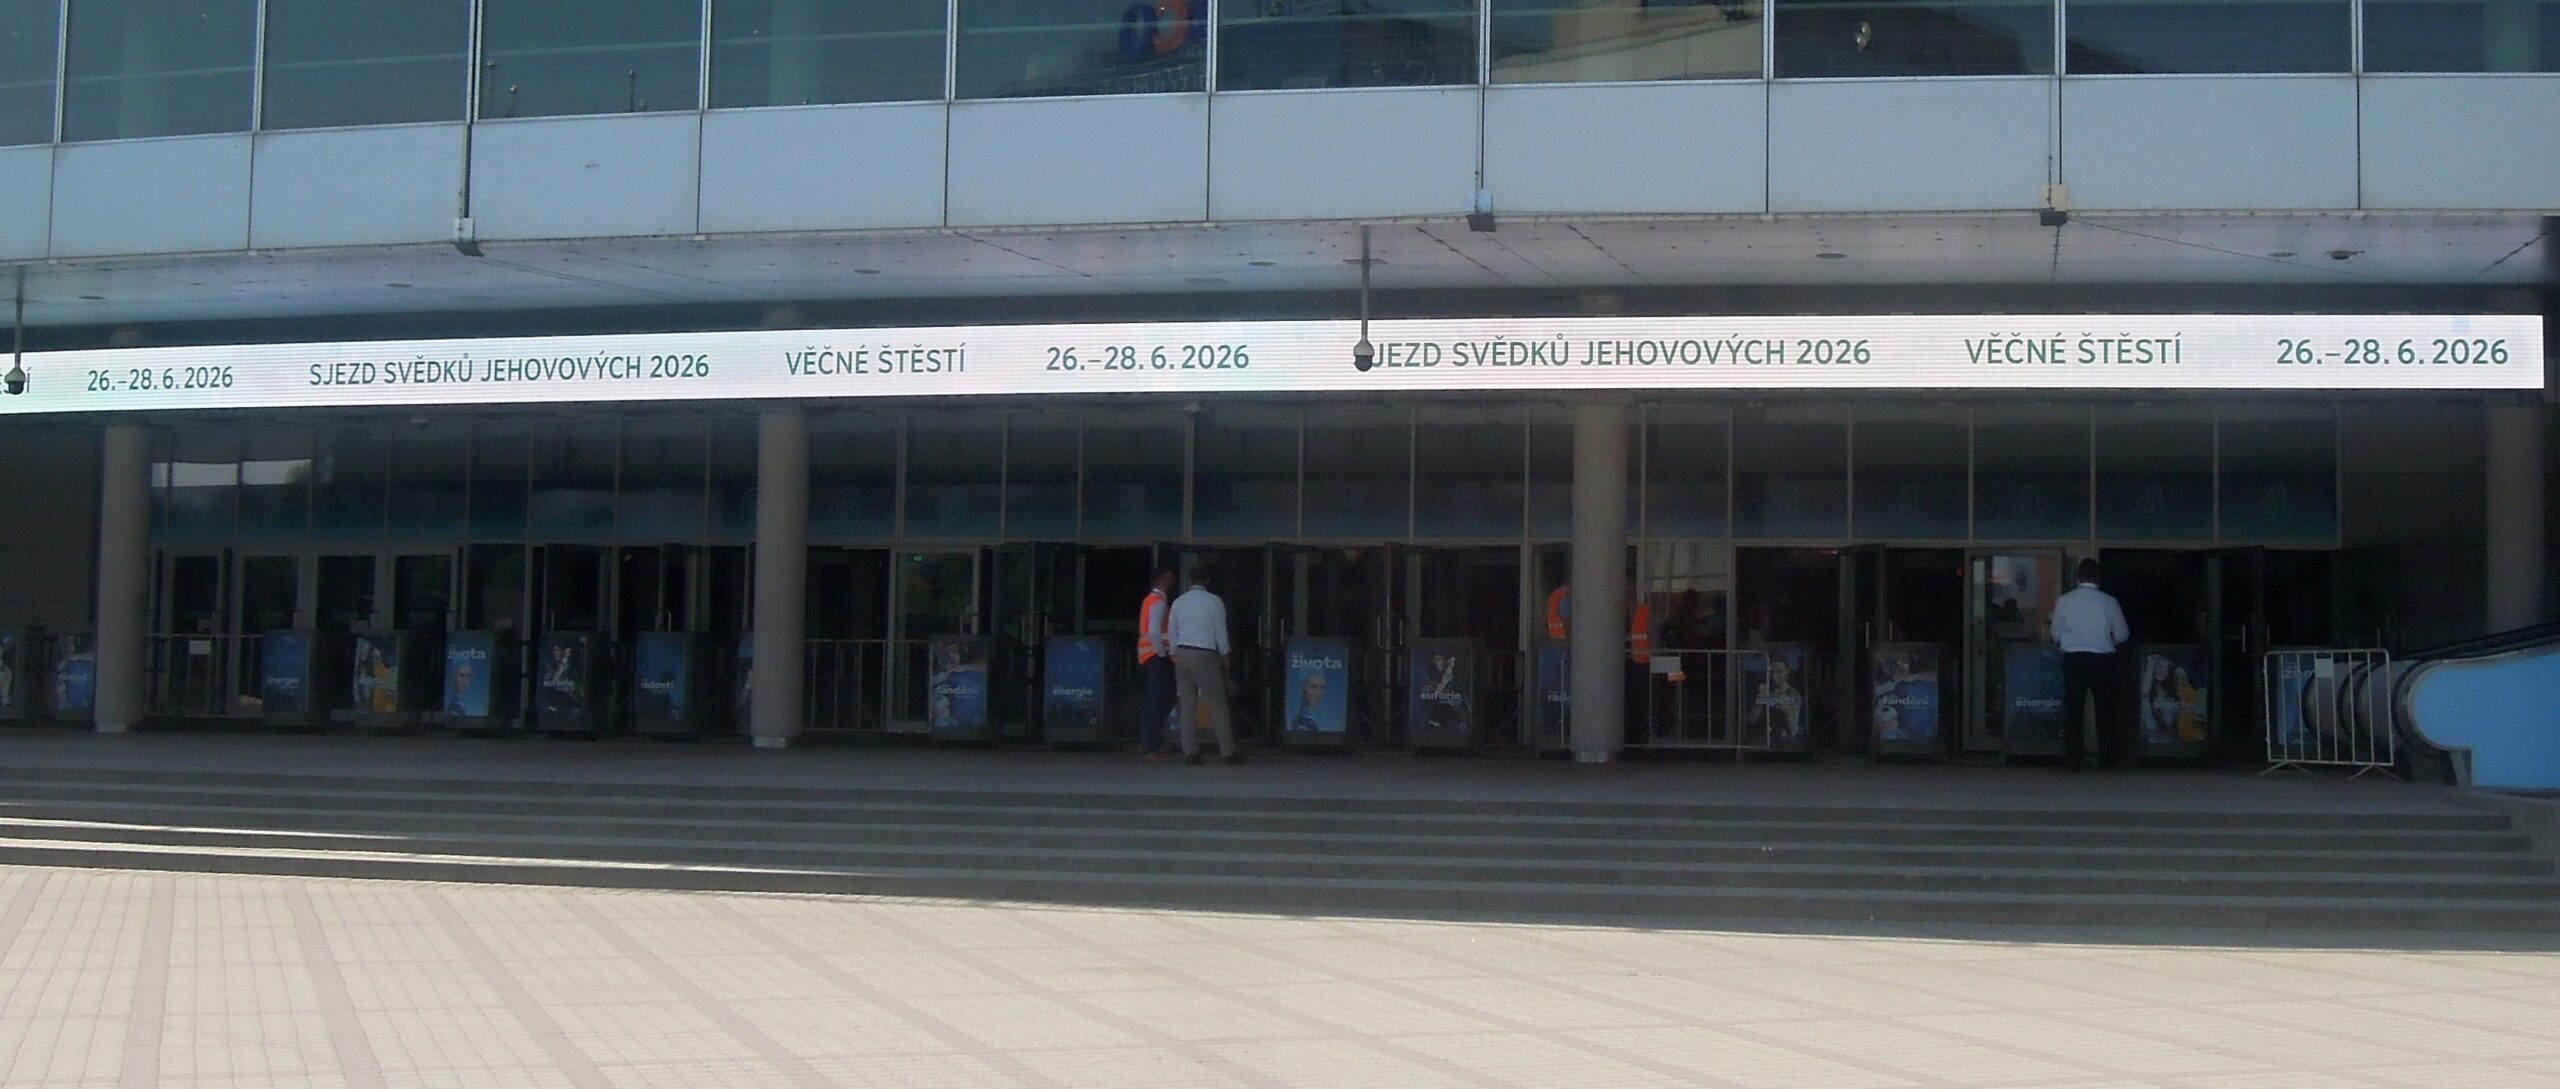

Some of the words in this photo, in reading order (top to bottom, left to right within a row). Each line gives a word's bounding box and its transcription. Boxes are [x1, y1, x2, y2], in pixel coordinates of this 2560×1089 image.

[784, 344, 869, 376] VĚČNÉ
[878, 341, 966, 374] ŠTĚSTÍ
[1181, 344, 1250, 369] 2026
[1368, 342, 1442, 368] JEZD
[1451, 333, 1570, 367] SVĚDKŮ
[1578, 332, 1785, 366] JEHOVOVÝCH
[1796, 339, 1871, 365] 2026
[1964, 332, 2067, 365] VĚČNÉ
[2077, 331, 2182, 365] ŠTĚSTÍ
[2431, 338, 2509, 365] 2026
[184, 365, 234, 389] 2026
[309, 362, 377, 386] SJEZD
[383, 352, 474, 385] SVĚDKŮ
[480, 349, 642, 383] JEHOVOVÝCH
[649, 353, 710, 379] 2026
[1290, 654, 1343, 669] života
[1052, 687, 1094, 698] energie
[2016, 697, 2062, 709] energie
